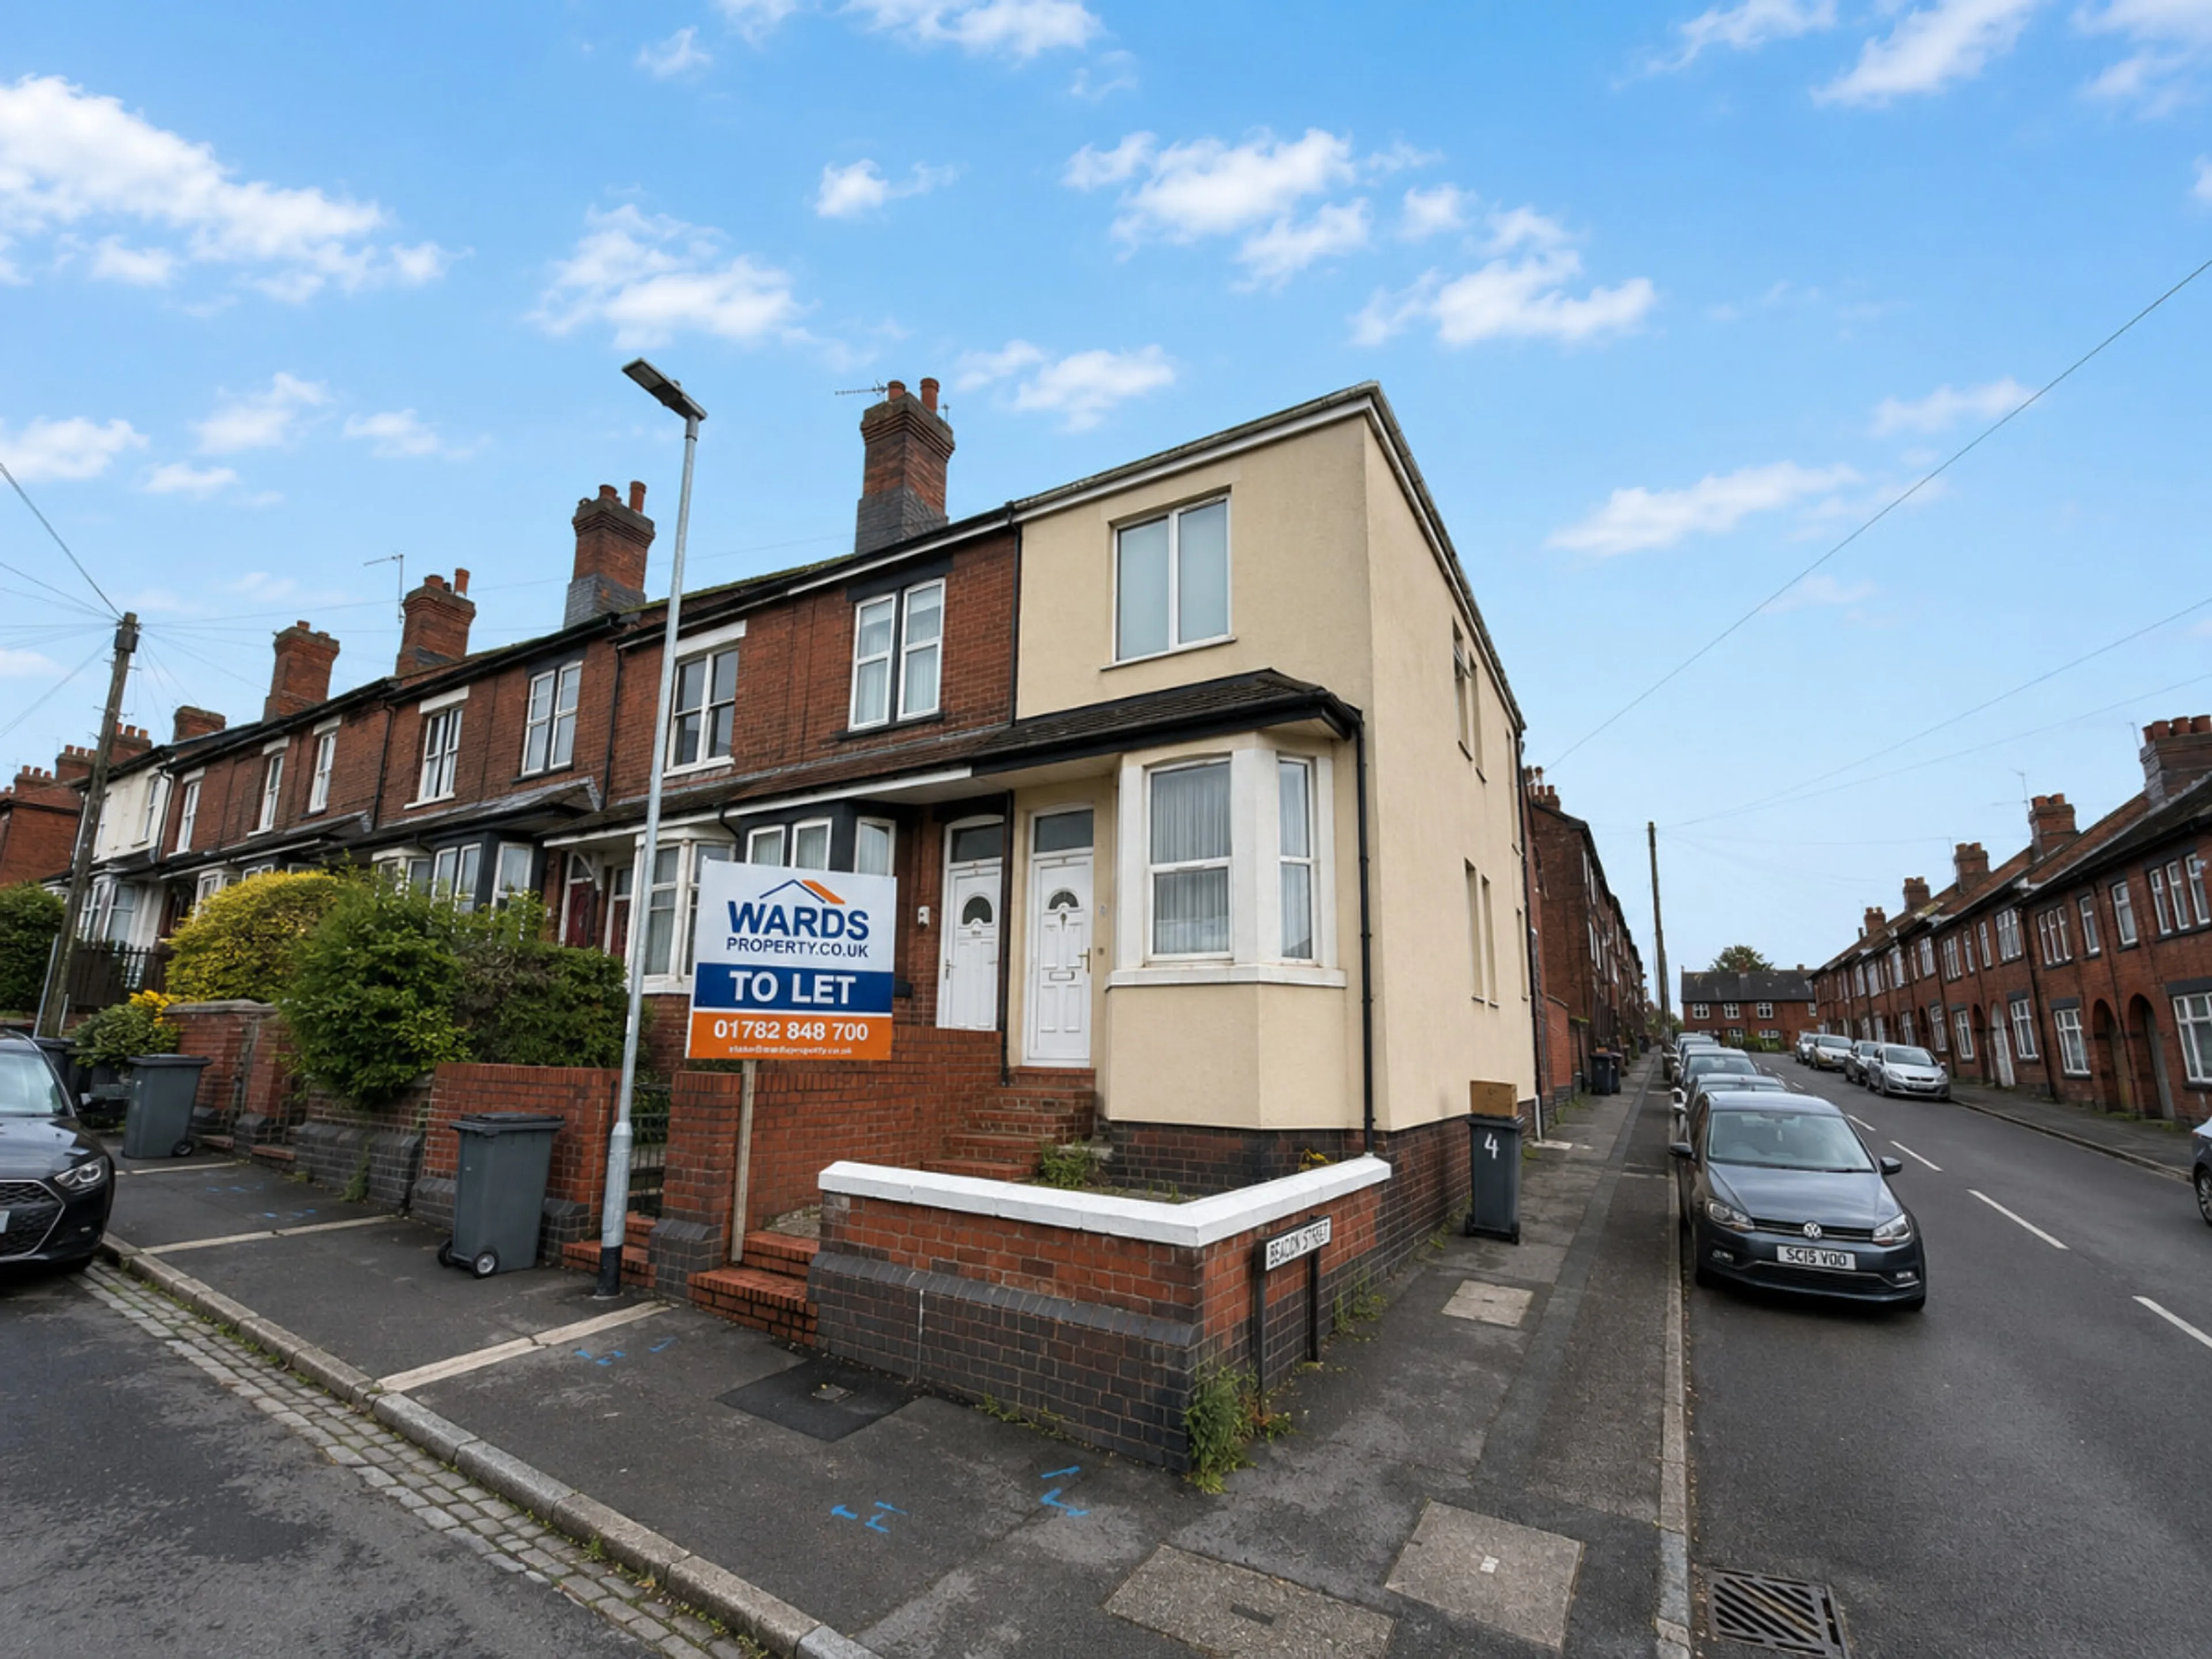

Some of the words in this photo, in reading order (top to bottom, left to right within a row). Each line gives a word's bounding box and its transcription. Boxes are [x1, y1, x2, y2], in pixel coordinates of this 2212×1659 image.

[728, 900, 869, 940] WARDS
[726, 937, 869, 958] PROPERTY.CO.UK
[729, 971, 778, 1002] TO
[791, 973, 857, 1005] LET
[713, 1019, 781, 1040] 01782
[786, 1022, 825, 1041] 848
[832, 1022, 869, 1041] 700
[1483, 1132, 1499, 1160] 4
